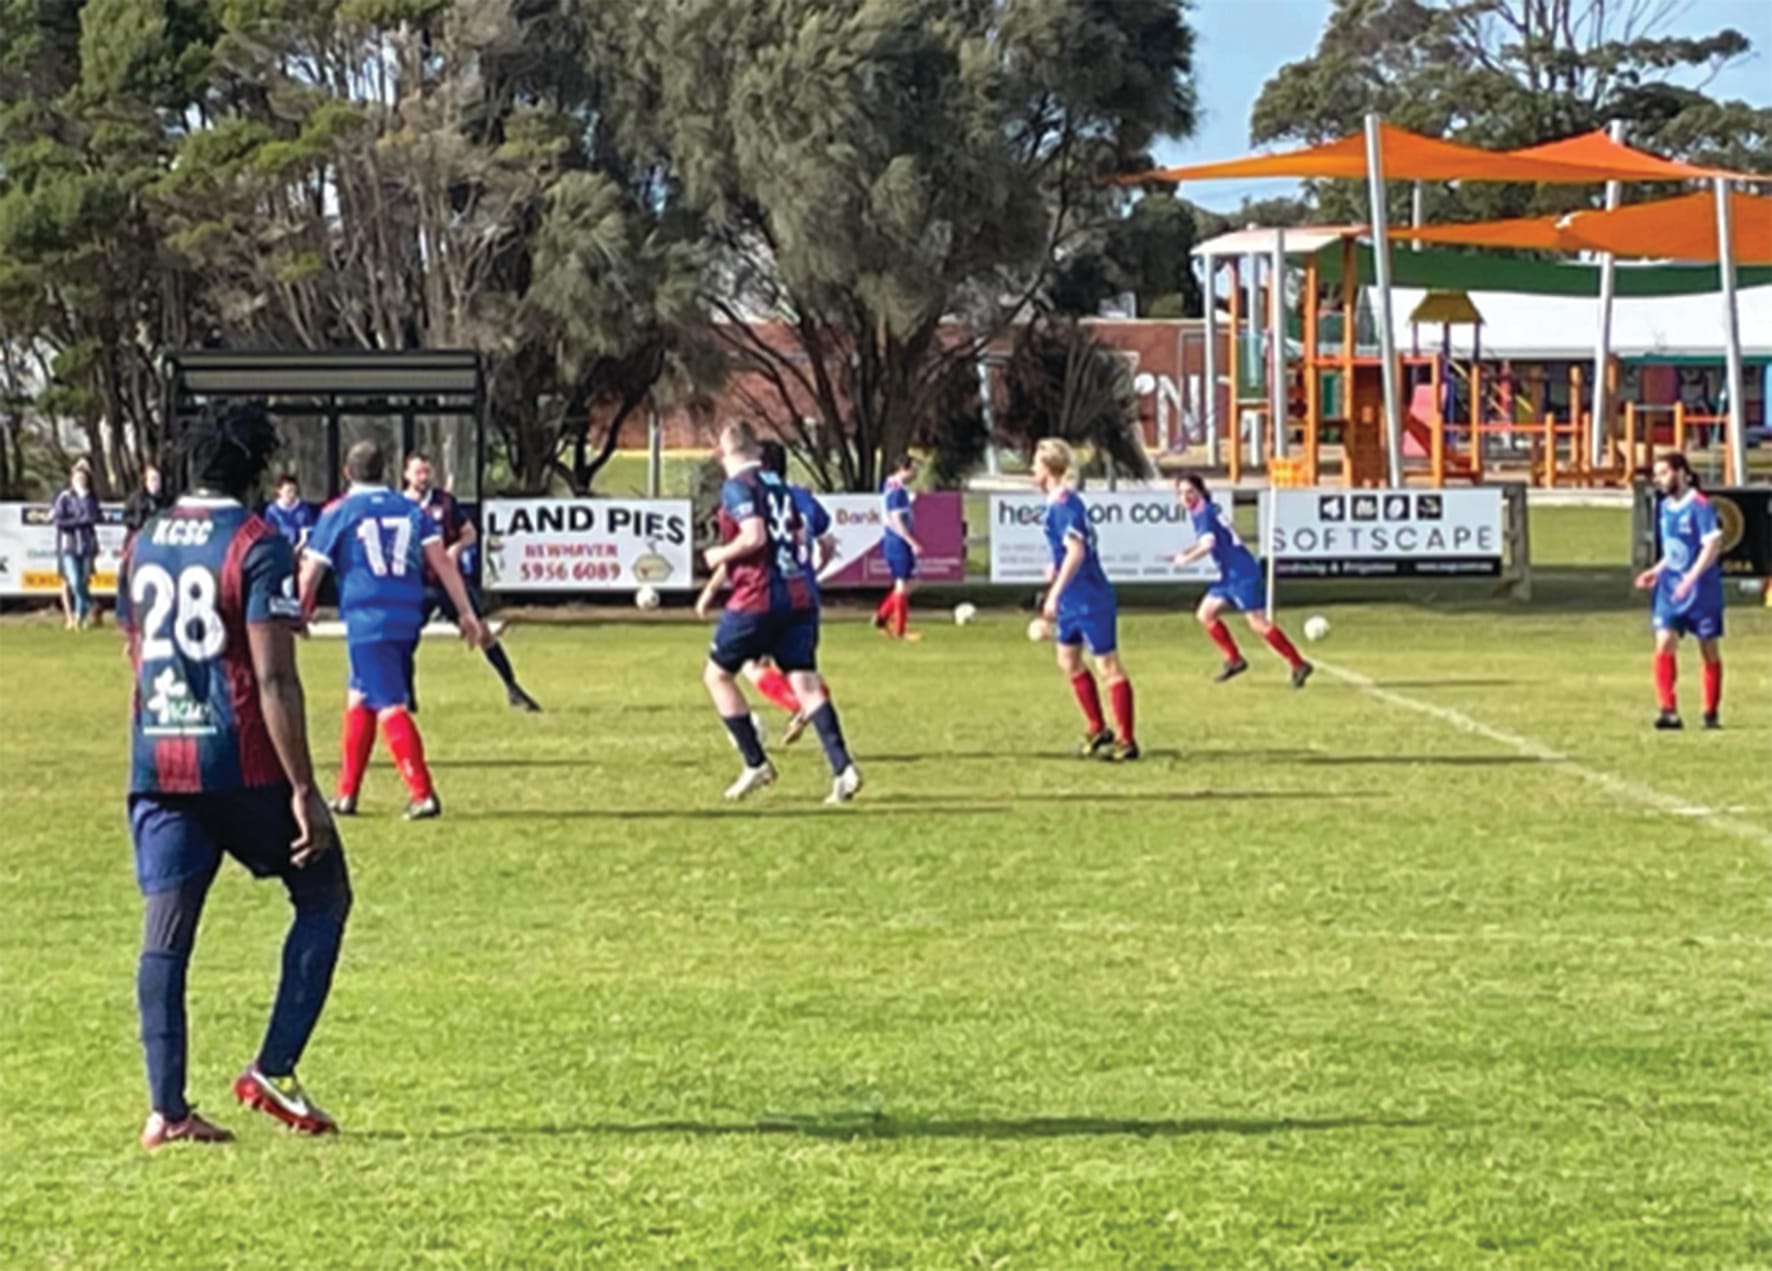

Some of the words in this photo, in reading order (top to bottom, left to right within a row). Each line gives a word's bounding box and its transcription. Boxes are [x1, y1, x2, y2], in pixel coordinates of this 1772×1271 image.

[607, 507, 685, 545] PIES
[836, 508, 880, 525] Bank
[152, 518, 213, 545] KCSC
[1273, 527, 1493, 552] SOFTSCAPE
[357, 517, 411, 577] 17
[525, 543, 617, 558] NEWHAVEN
[521, 562, 567, 580] 5956
[572, 562, 621, 580] 6089
[131, 564, 227, 661] 28
